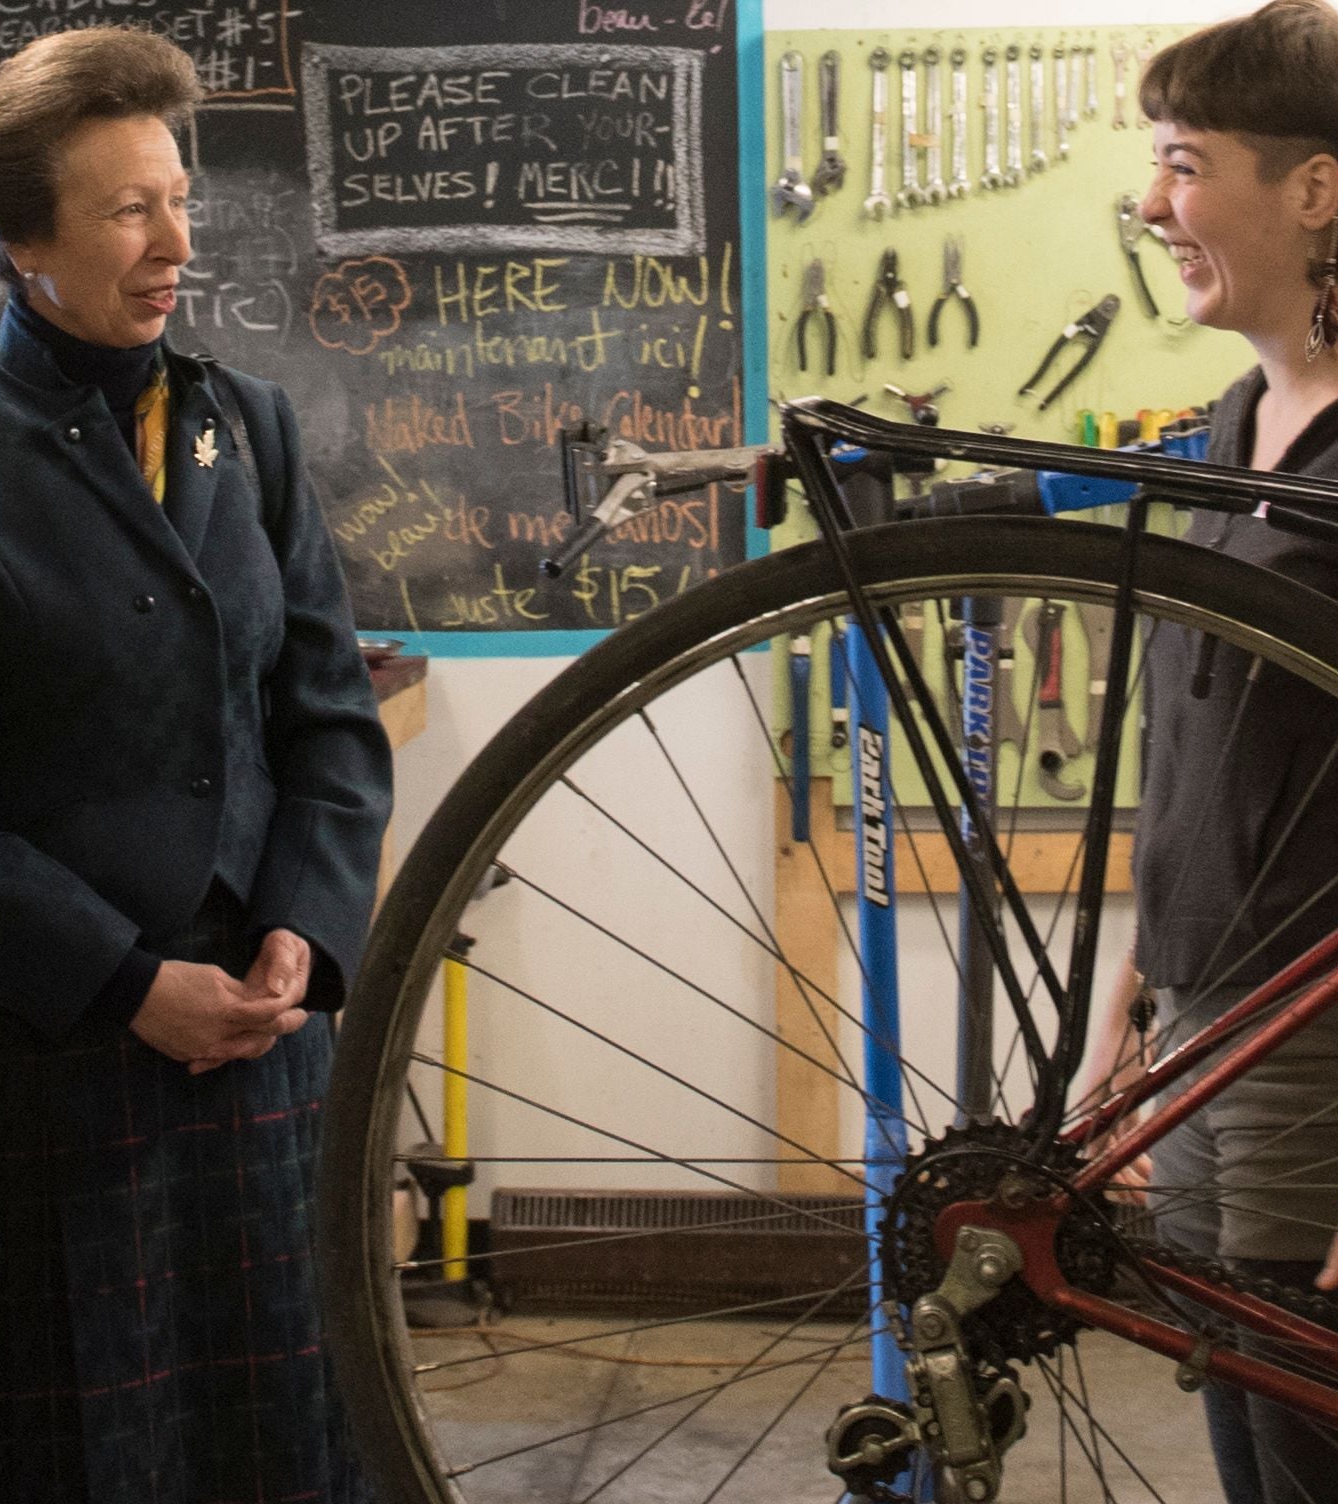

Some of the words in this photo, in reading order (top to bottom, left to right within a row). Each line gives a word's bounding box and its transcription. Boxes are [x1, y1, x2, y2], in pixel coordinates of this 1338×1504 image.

[339, 71, 512, 116] PLEASE
[525, 69, 668, 104] CLEAN
[344, 122, 402, 162] UP
[416, 112, 558, 152] AFTER
[341, 160, 501, 210] SELVES!
[434, 257, 571, 327] HERE
[601, 241, 733, 331] NOW!
[378, 308, 622, 379] maintenant
[640, 314, 708, 399] ici!
[963, 625, 994, 737] PARK
[858, 725, 887, 819] Park
[862, 821, 890, 908] Tool
